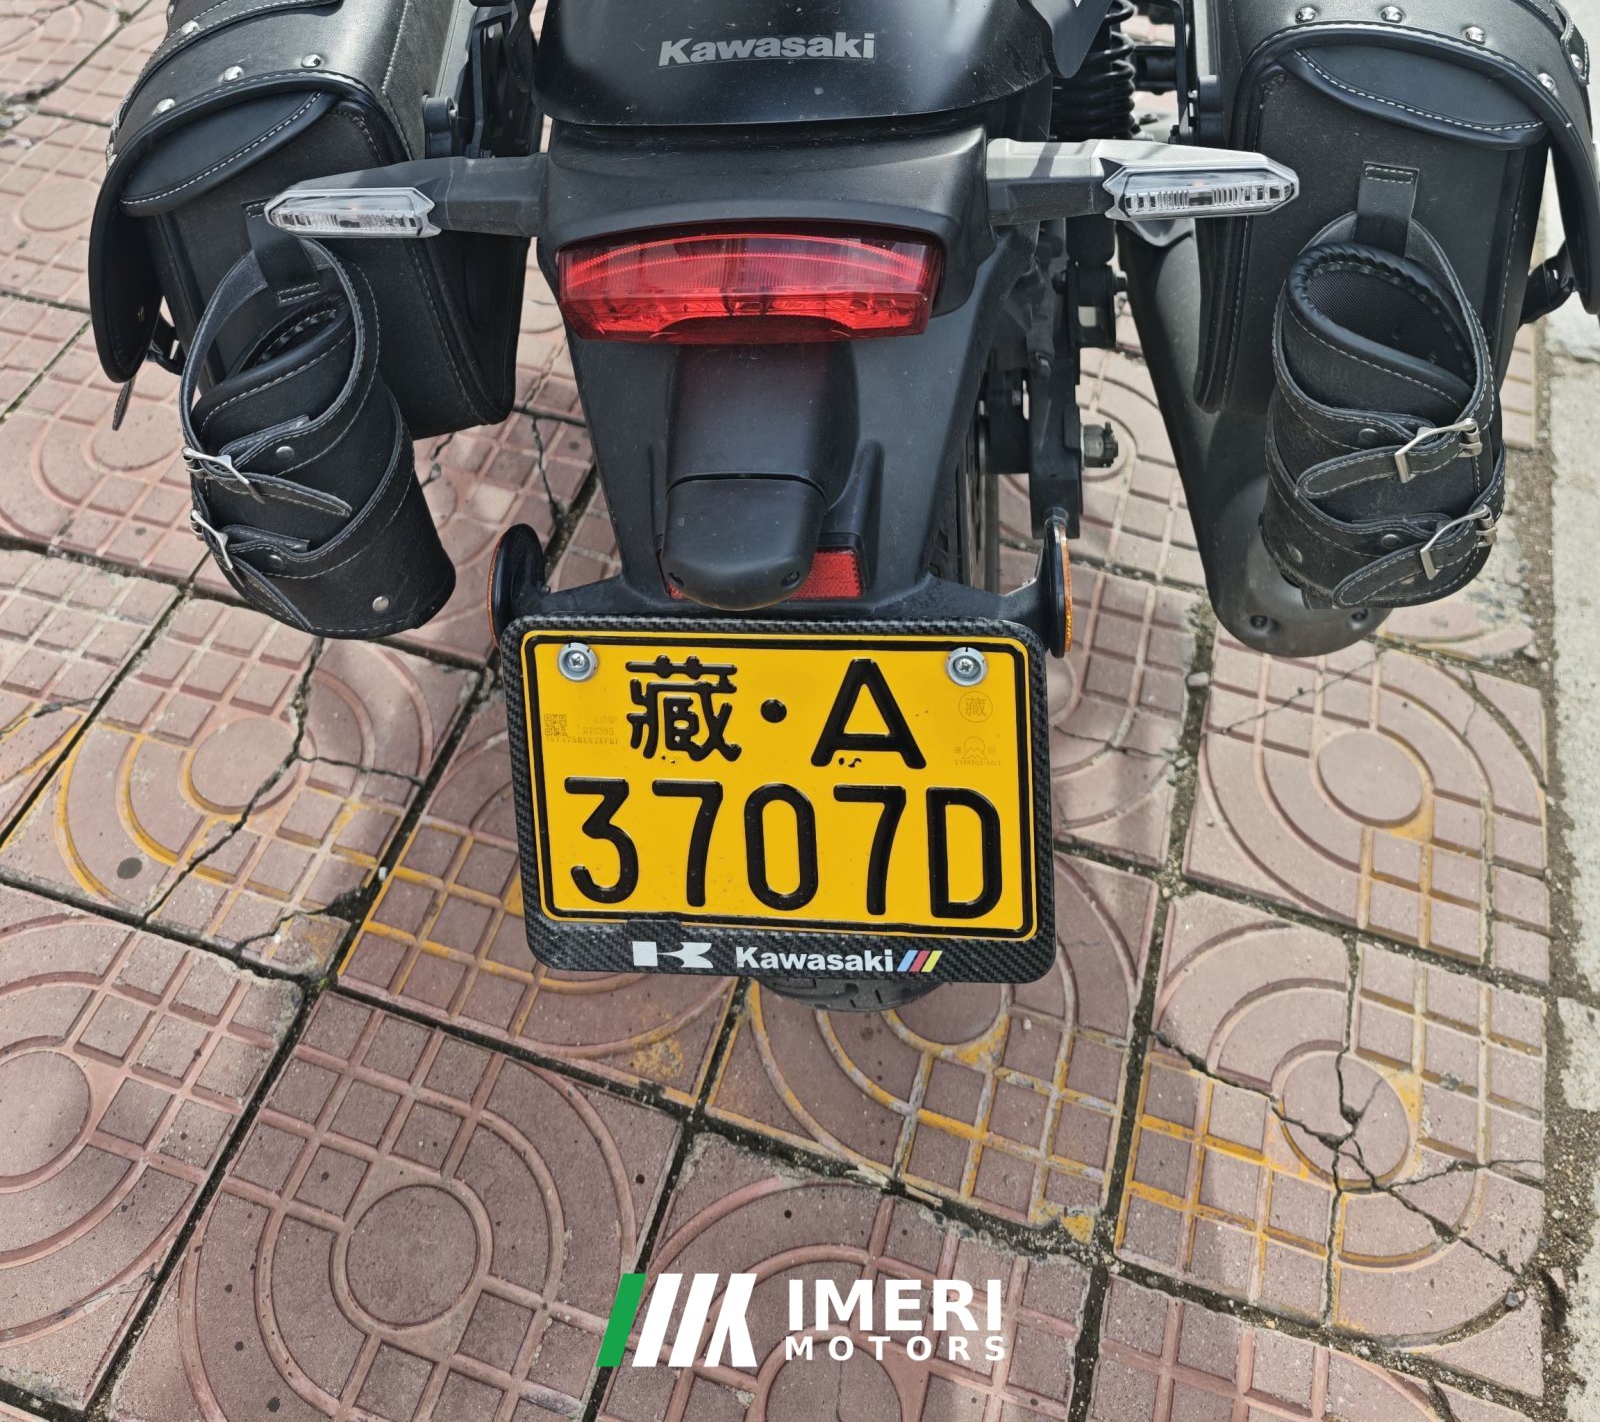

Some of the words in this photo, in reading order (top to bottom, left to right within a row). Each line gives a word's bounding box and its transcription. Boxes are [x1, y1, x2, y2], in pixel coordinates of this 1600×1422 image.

[658, 31, 875, 67] Kawasaki
[564, 777, 1002, 918] 3707D
[736, 946, 894, 973] Kawasaki
